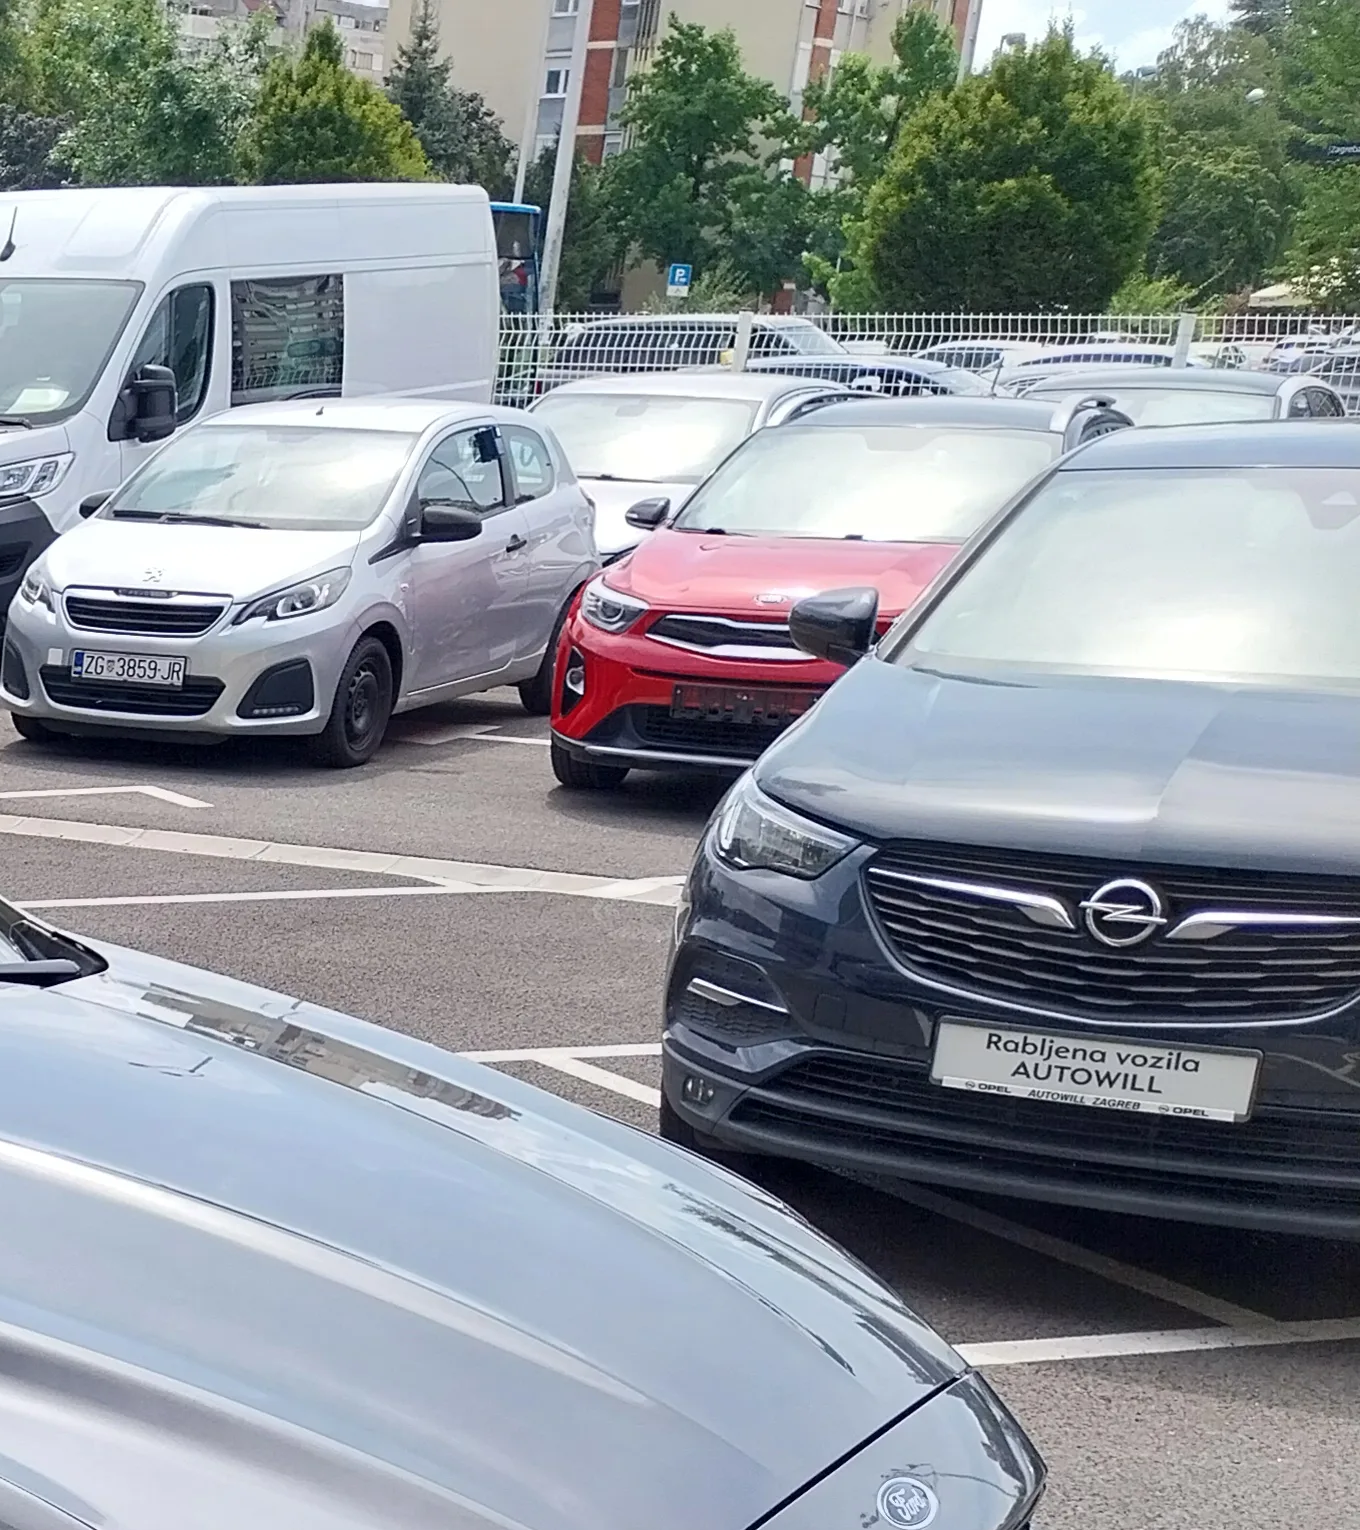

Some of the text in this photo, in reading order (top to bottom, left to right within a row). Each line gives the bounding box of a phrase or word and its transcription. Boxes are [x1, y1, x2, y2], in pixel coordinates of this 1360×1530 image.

[84, 655, 182, 681] ZG 3859-JR
[985, 1032, 1201, 1073] Rabljena vozila
[1010, 1060, 1163, 1094] AUTOWILL
[977, 1083, 1210, 1118] OPEL AUTOWILL ZAGREB OPEL
[888, 1488, 927, 1521] Ford
